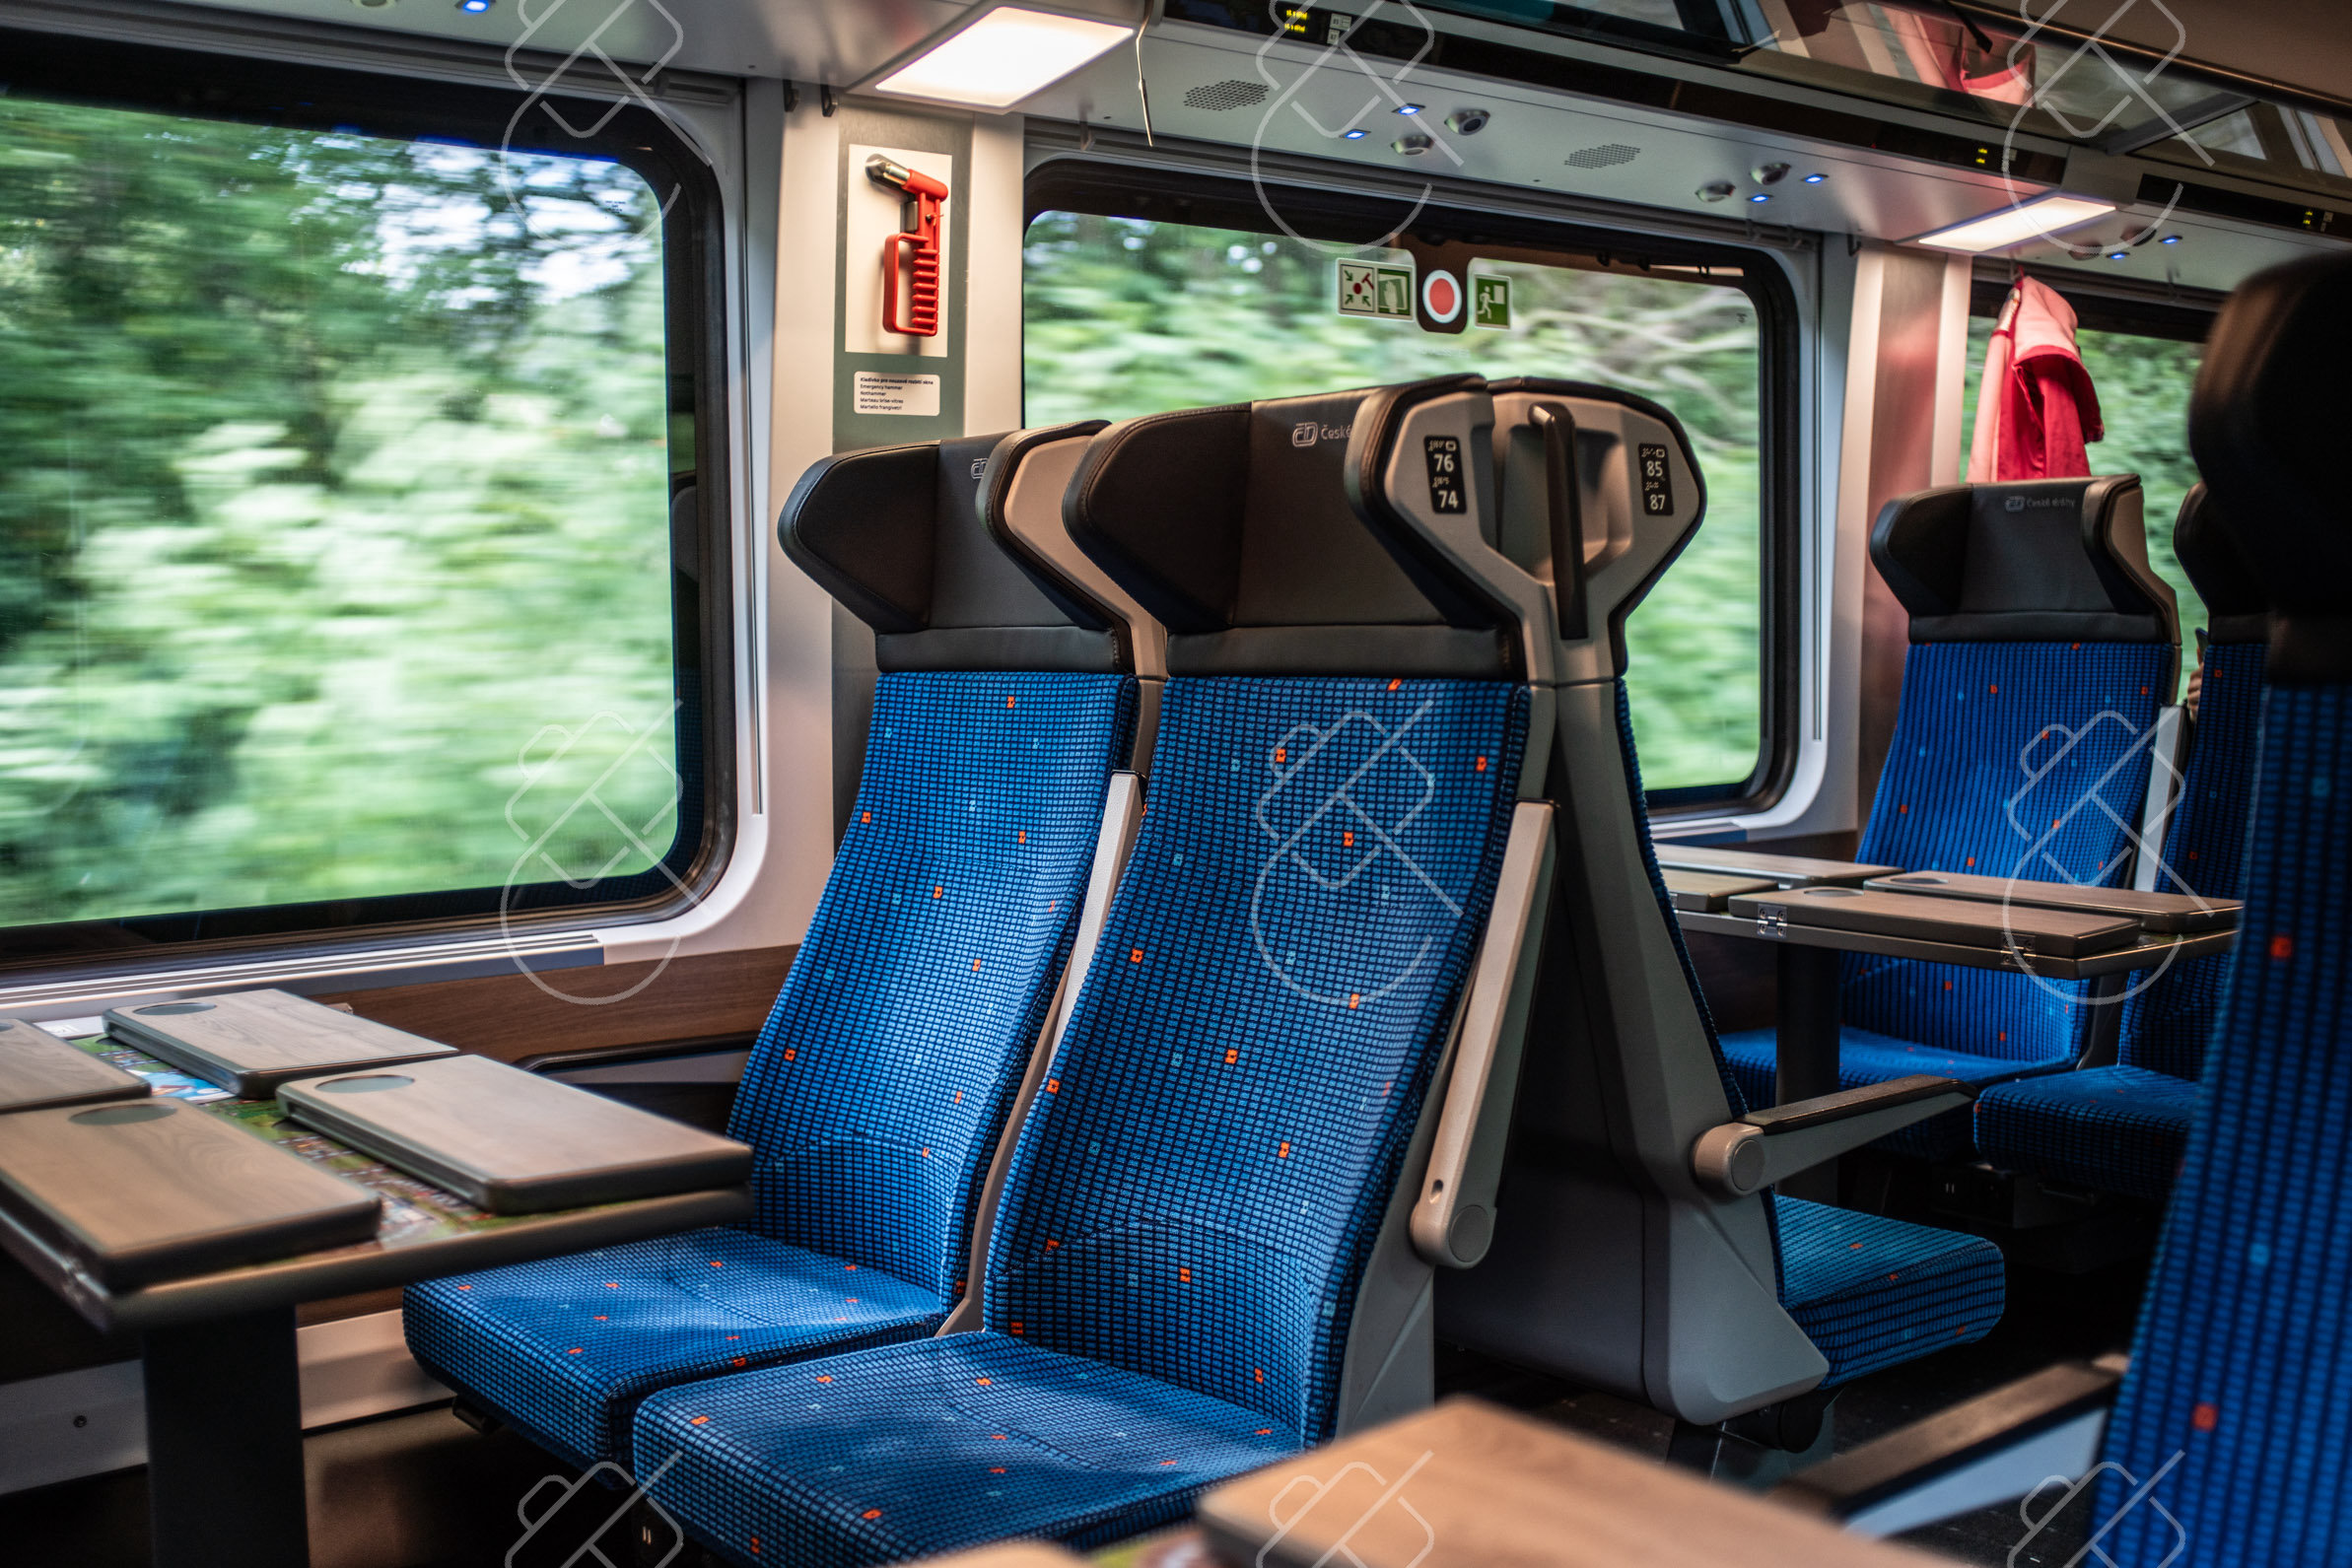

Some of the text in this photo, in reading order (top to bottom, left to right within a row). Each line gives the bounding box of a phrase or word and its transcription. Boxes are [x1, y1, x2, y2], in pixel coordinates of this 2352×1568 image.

[1433, 453, 1455, 472] 76
[1646, 460, 1663, 477] 85
[1438, 490, 1459, 509] 74
[1649, 494, 1666, 511] 87
